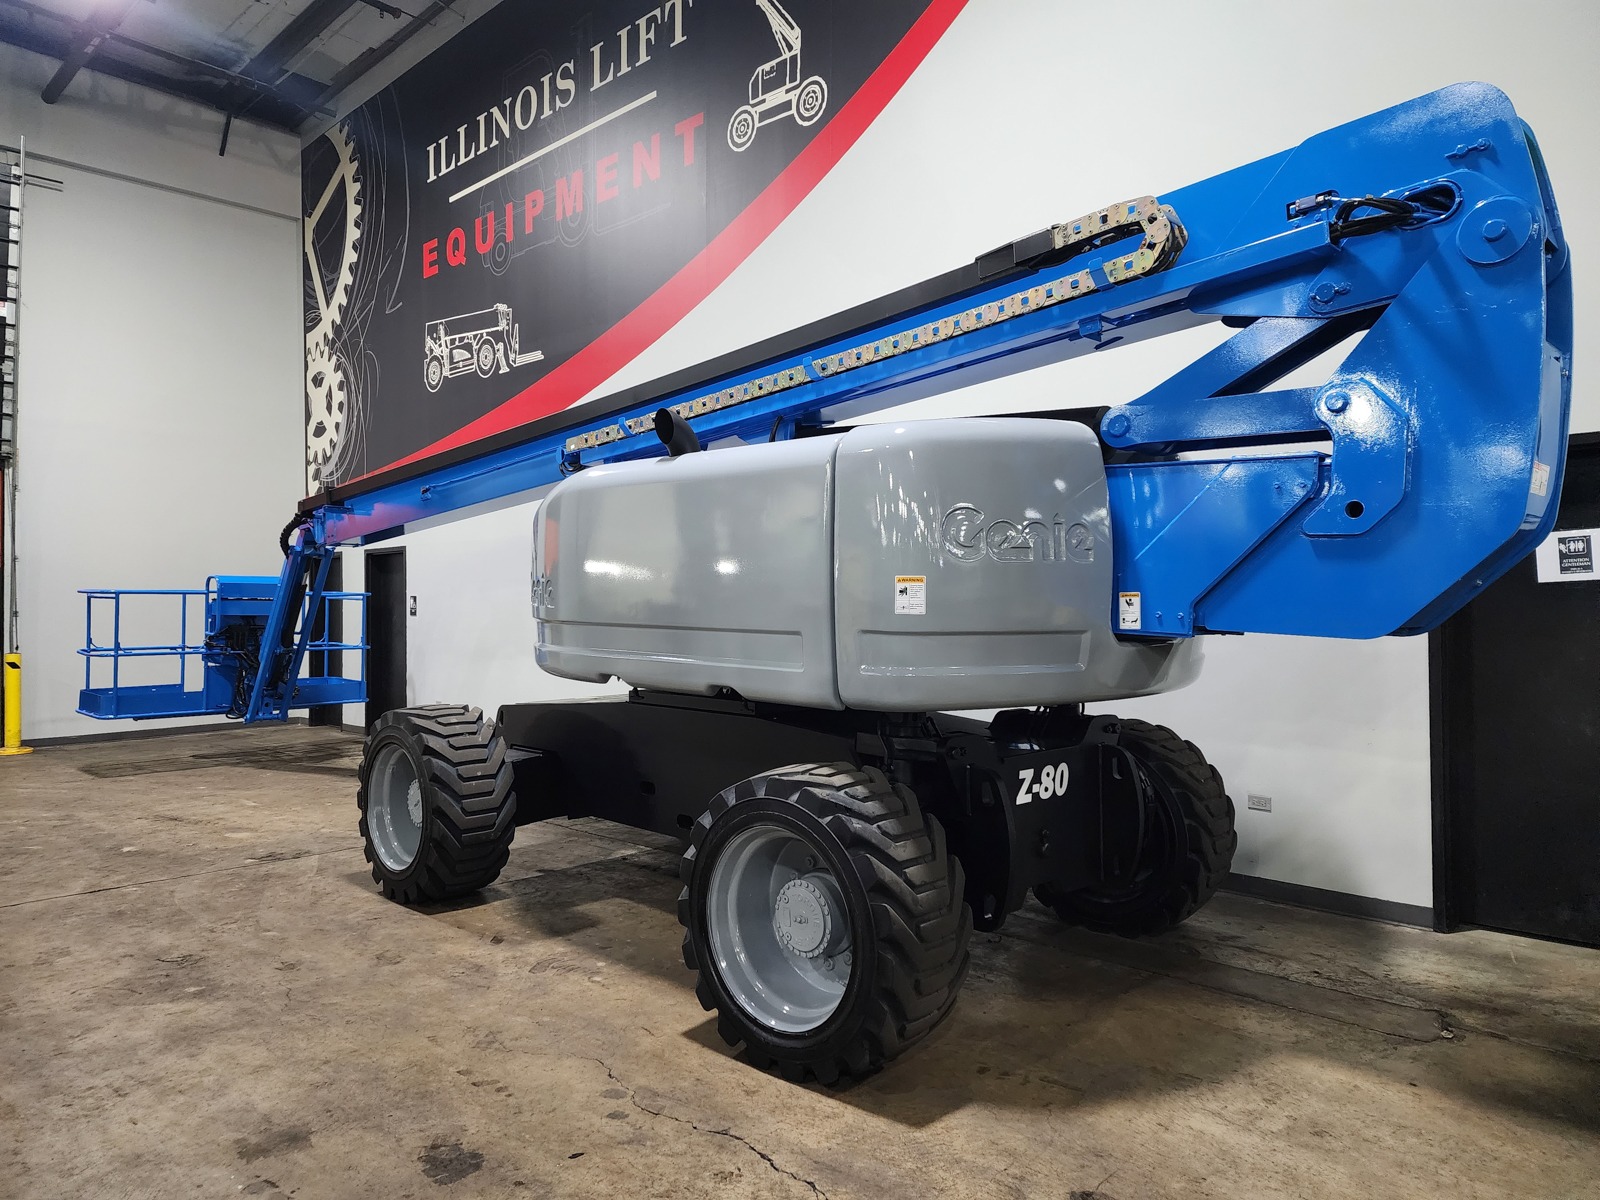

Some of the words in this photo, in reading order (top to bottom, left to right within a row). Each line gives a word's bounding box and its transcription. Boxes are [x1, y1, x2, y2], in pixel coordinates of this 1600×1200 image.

[427, 59, 576, 183] ILLINOIS
[590, 0, 694, 92] LIFT
[423, 112, 704, 279] EQUIPMENT
[941, 502, 1094, 563] Genie
[1016, 762, 1069, 805] Z-80
